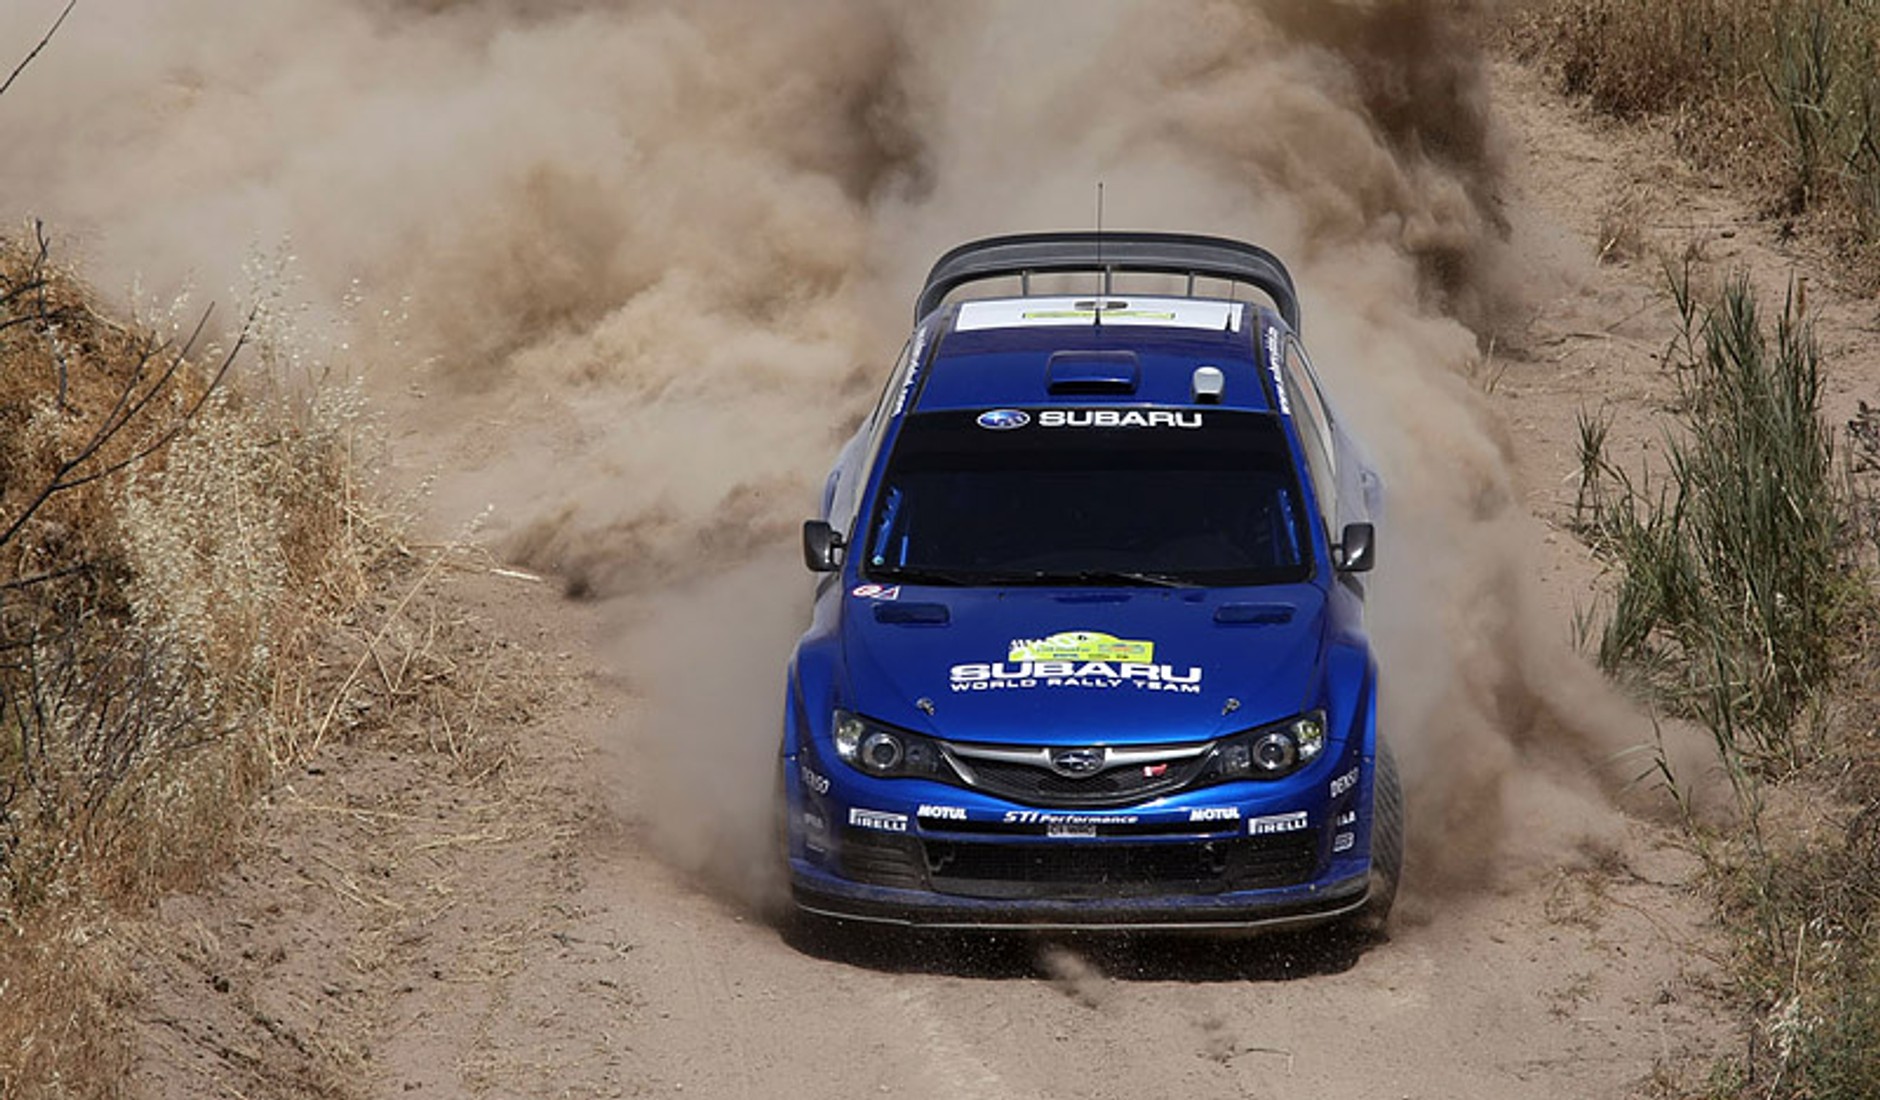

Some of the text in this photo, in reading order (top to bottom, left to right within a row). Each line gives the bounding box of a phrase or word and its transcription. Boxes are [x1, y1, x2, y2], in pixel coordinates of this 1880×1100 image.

[1038, 411, 1203, 428] SUBARU
[950, 661, 1202, 683] SUBARU
[951, 678, 1201, 693] WORLD RALLY TEAM
[848, 807, 908, 832] PIRELLI
[917, 804, 967, 820] MOTUL
[1003, 810, 1139, 824] STI Performance
[1189, 806, 1240, 822] MOTUL
[1248, 810, 1307, 835] PIRELLI
